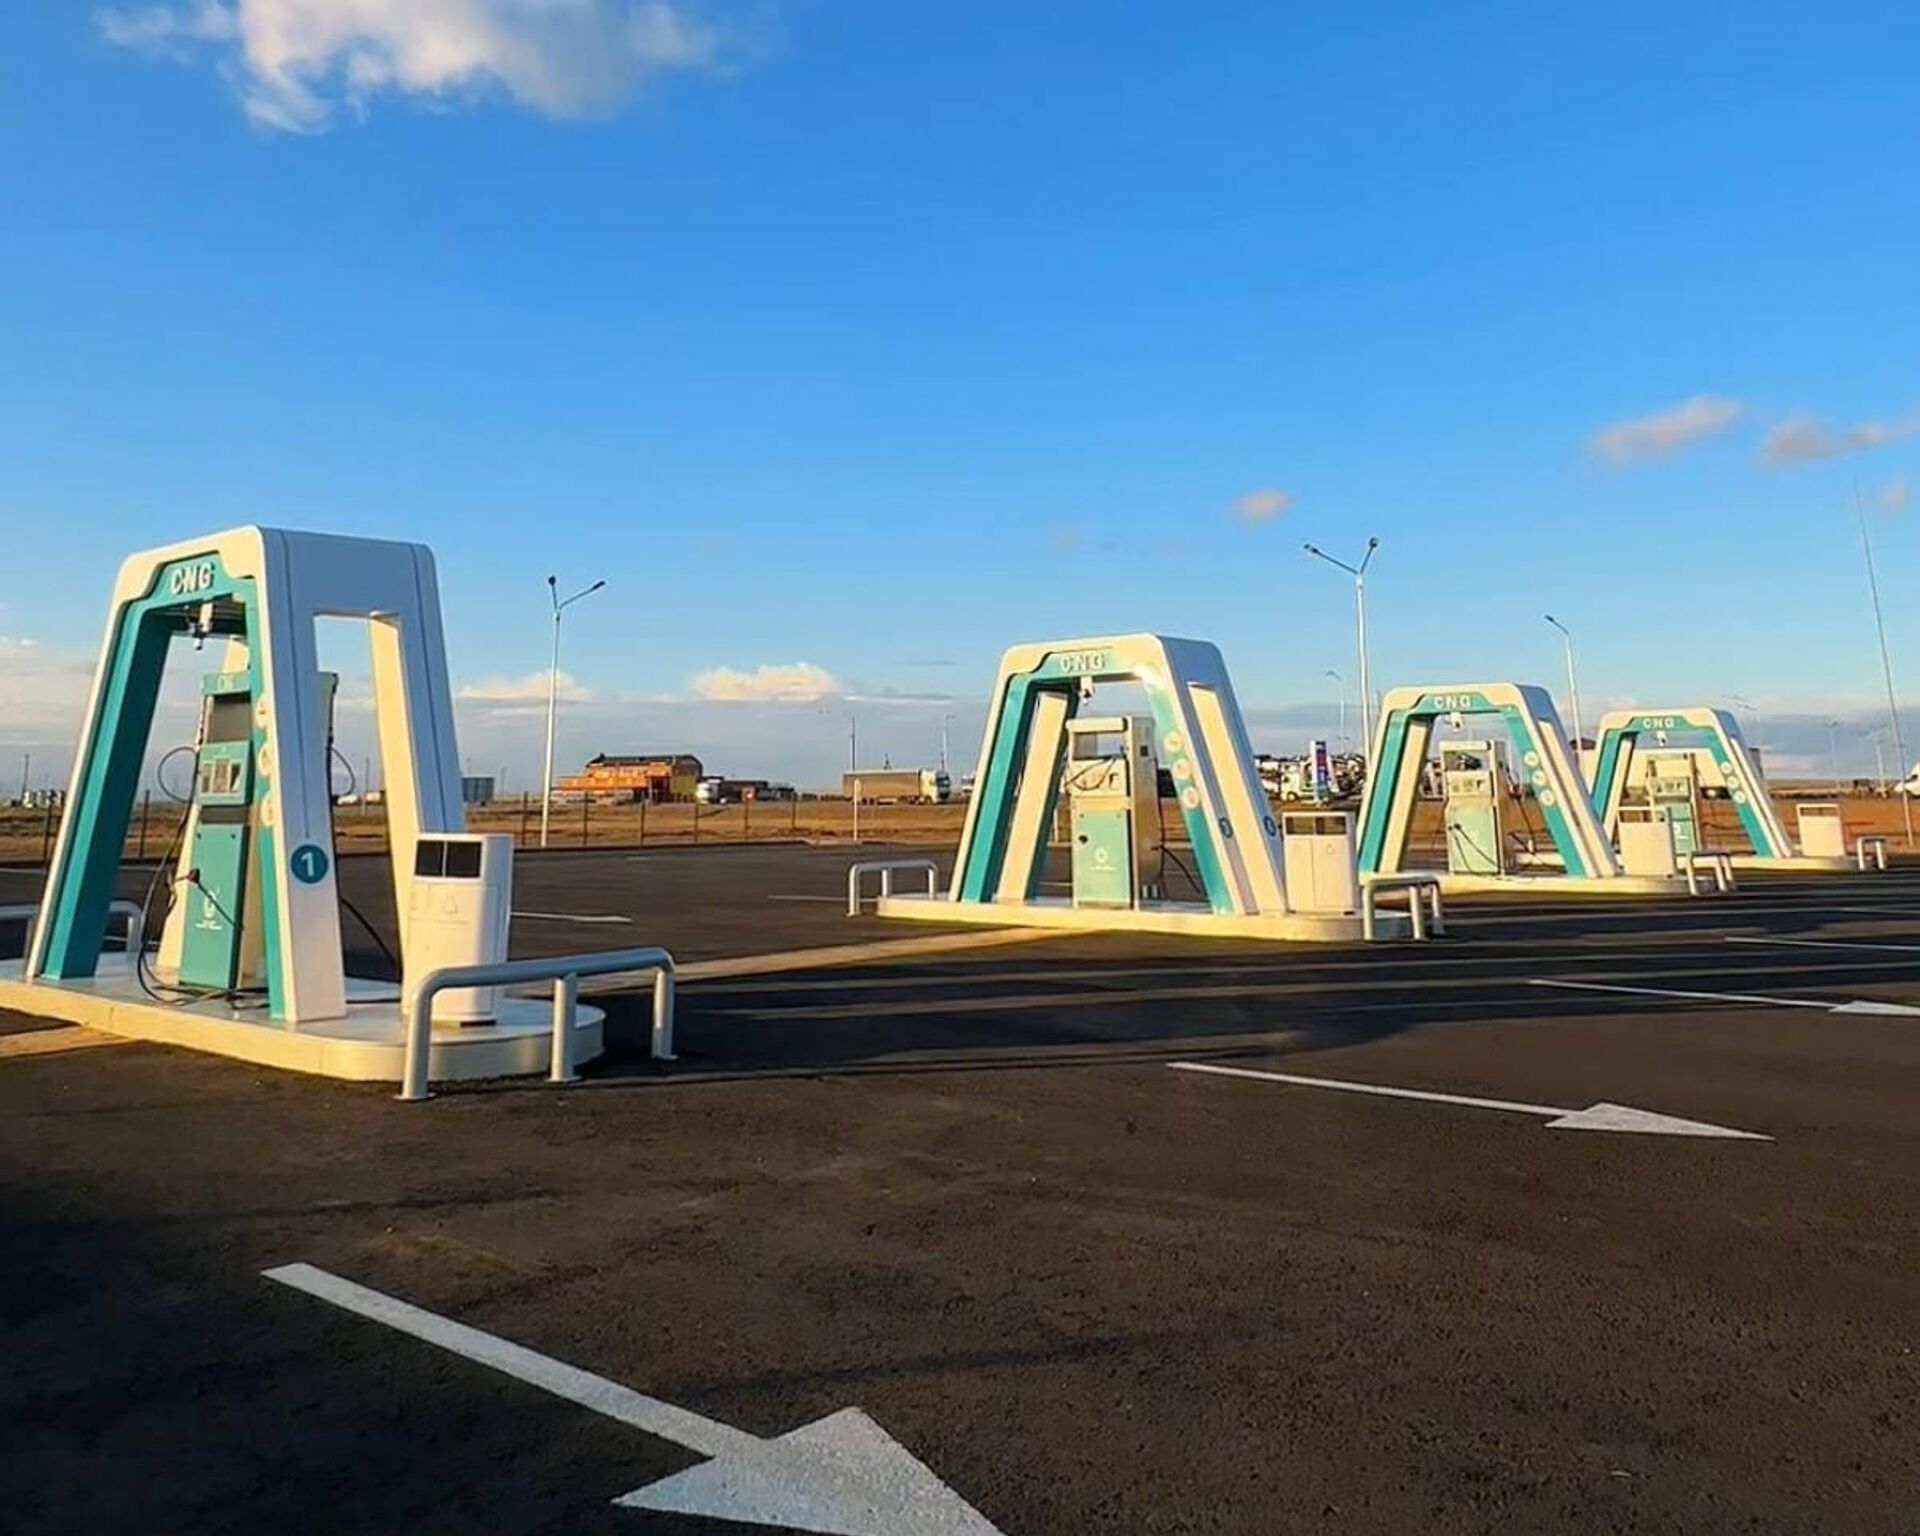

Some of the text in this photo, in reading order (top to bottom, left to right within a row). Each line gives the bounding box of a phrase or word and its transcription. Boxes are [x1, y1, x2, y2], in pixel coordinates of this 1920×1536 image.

[170, 561, 214, 596] CNG
[1060, 653, 1105, 672] CNG
[1433, 695, 1471, 709] CNG
[300, 851, 315, 877] 1
